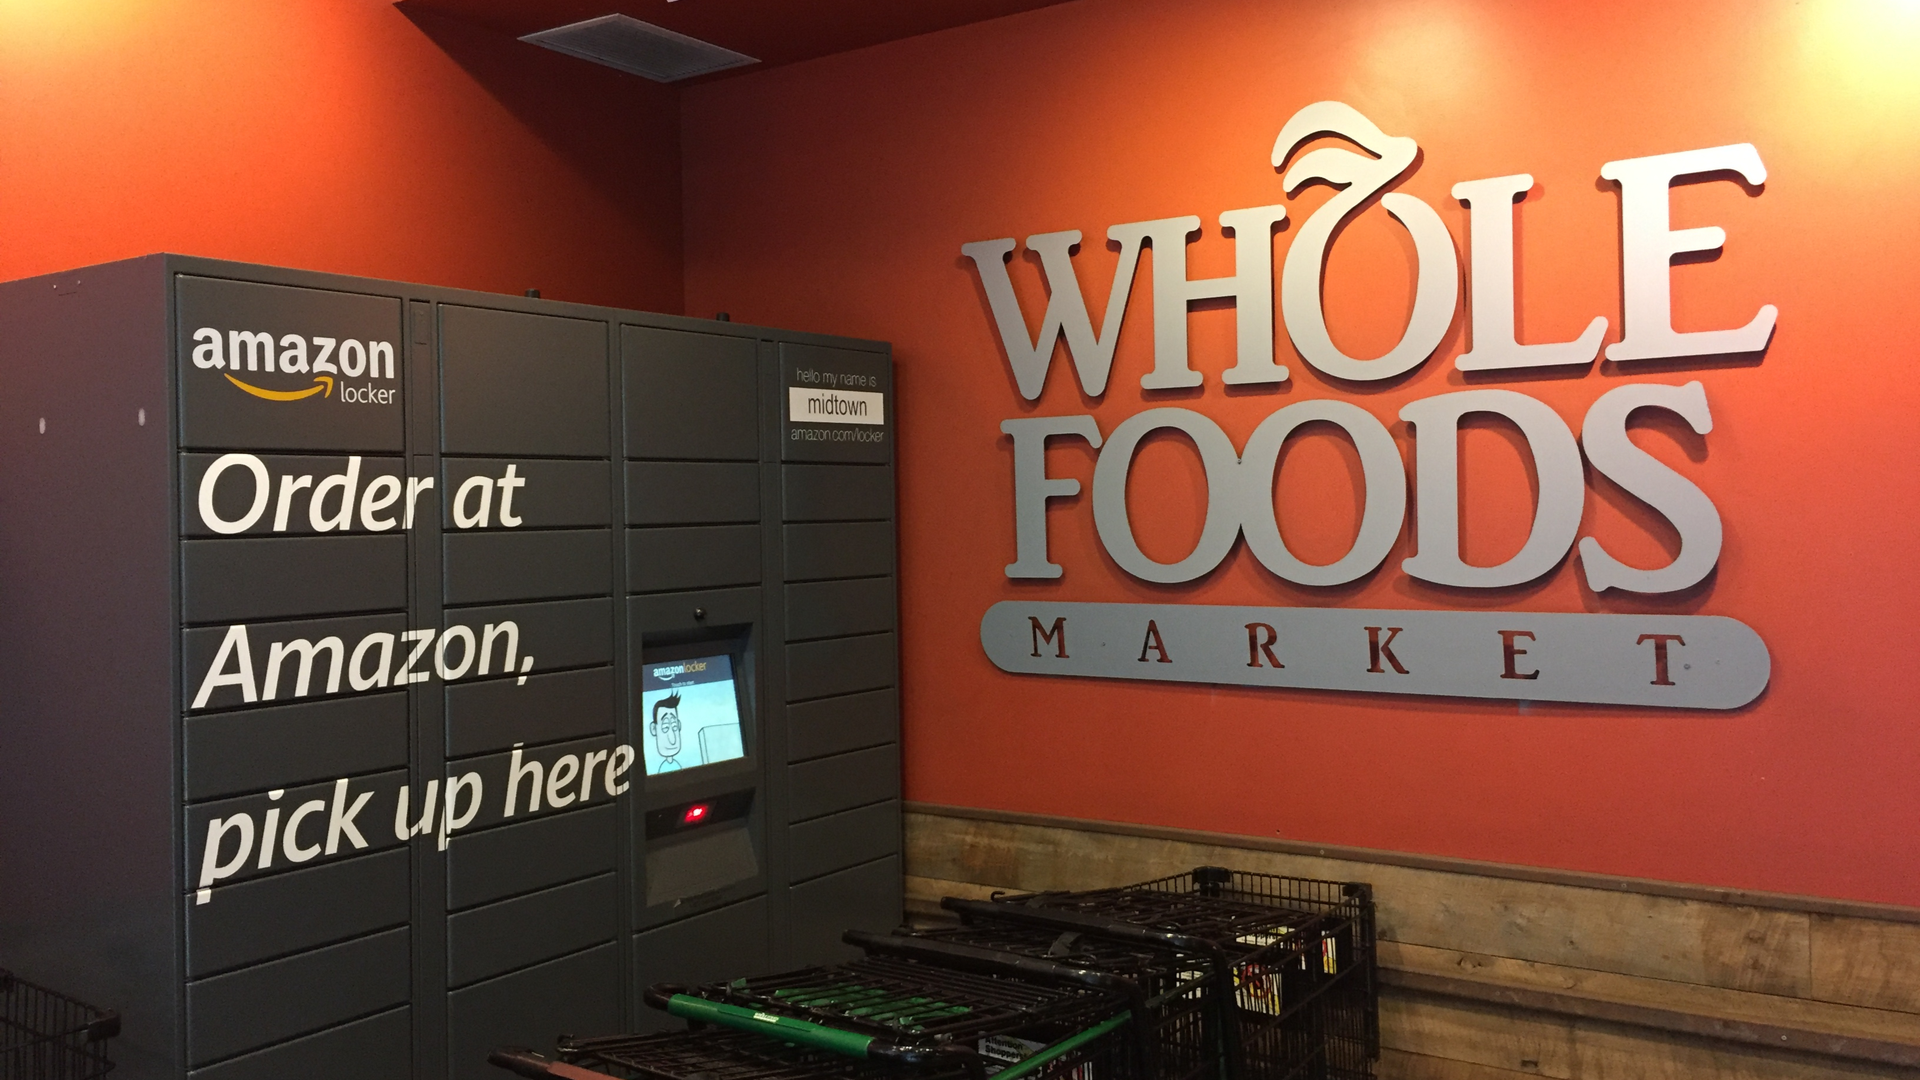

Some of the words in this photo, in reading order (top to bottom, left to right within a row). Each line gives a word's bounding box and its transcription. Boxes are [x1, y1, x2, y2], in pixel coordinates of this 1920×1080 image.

[961, 100, 1778, 400] WHOLE
[192, 326, 395, 379] amazon
[796, 367, 820, 384] hello
[822, 372, 838, 387] my
[840, 374, 867, 387] name
[869, 376, 877, 388] is
[340, 381, 395, 405] locker
[807, 393, 868, 416] midtown
[198, 453, 434, 534] Order
[453, 464, 526, 529] at
[1000, 380, 1724, 594] FOODS
[191, 620, 534, 709] Amazon,
[1028, 615, 1687, 687] MARKET
[196, 778, 374, 905] pick
[395, 772, 483, 851] up
[504, 742, 635, 817] here
